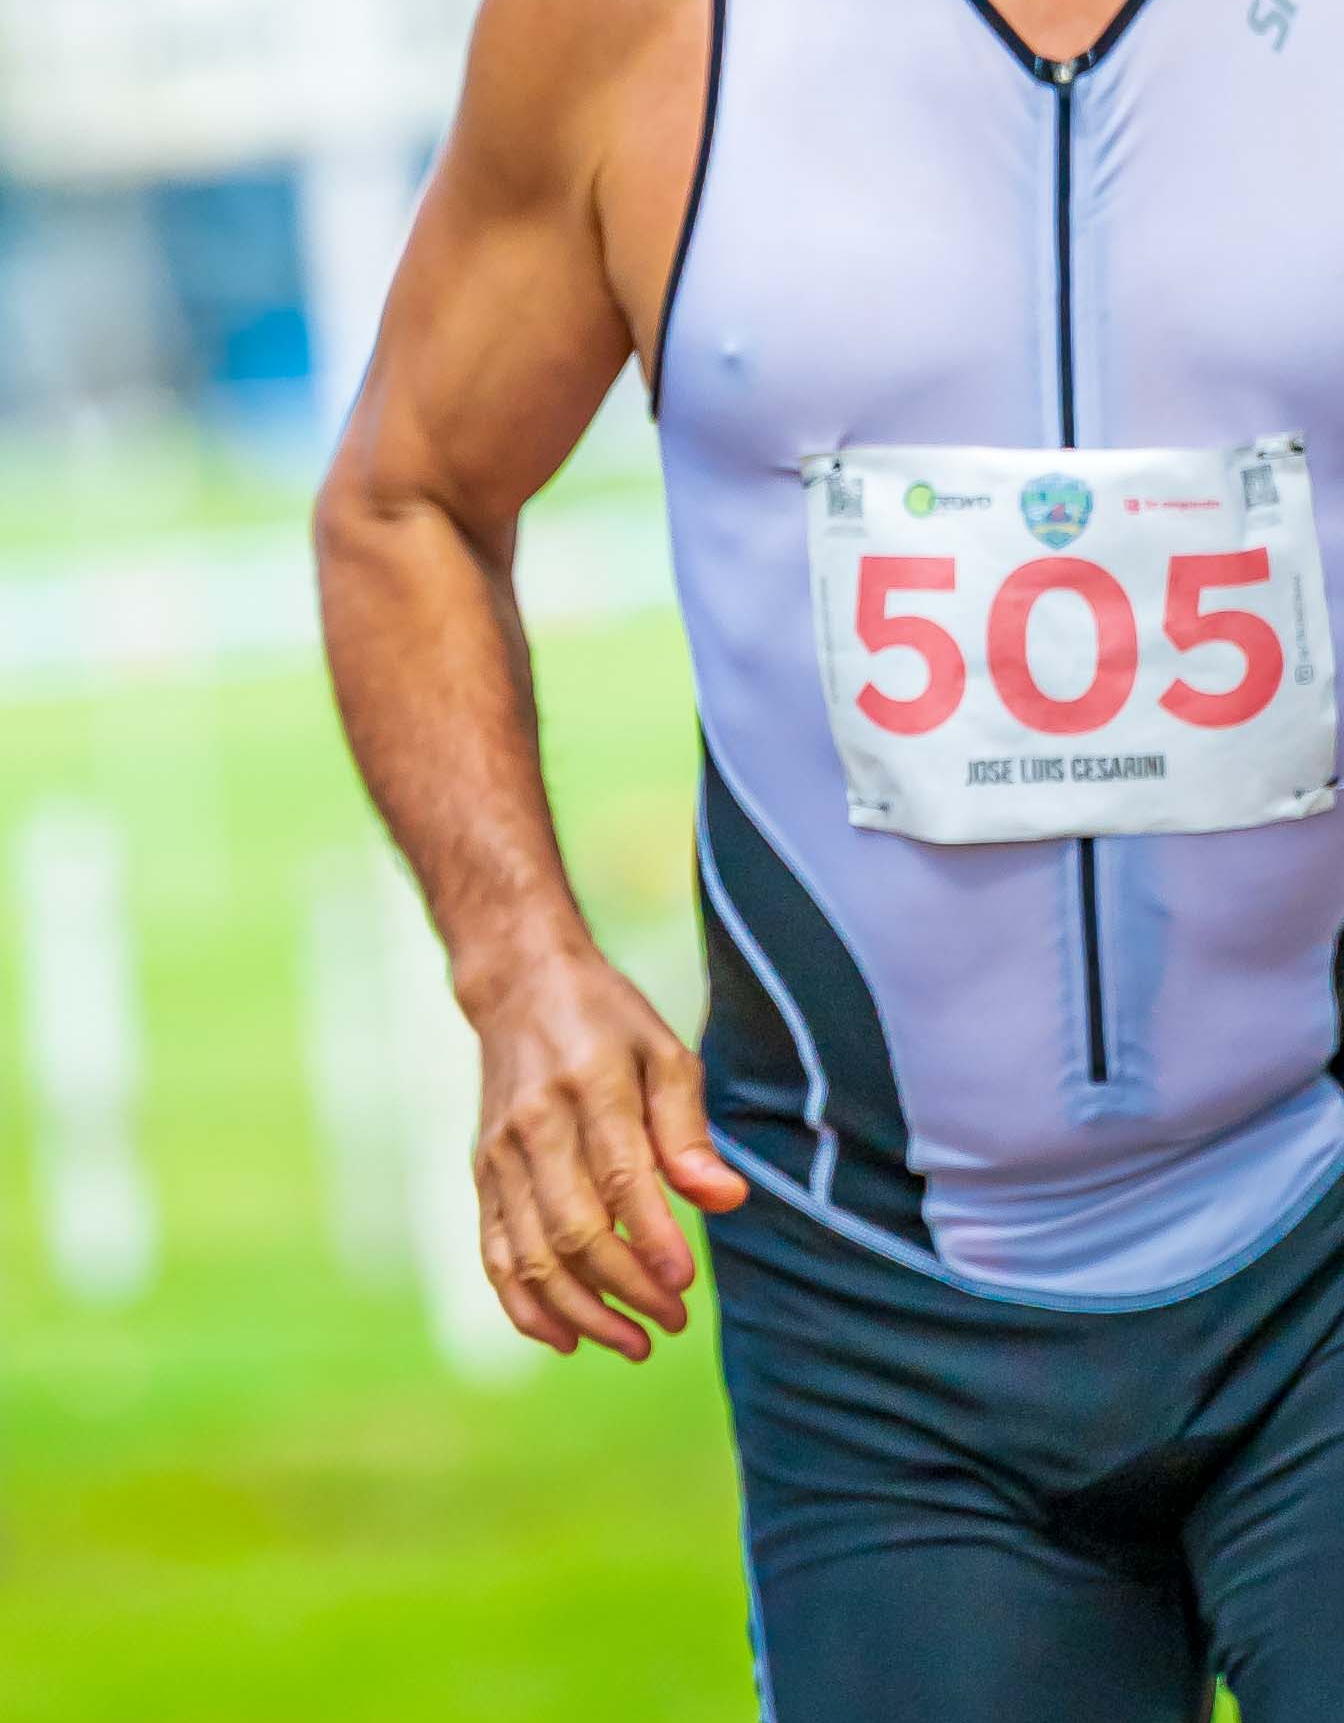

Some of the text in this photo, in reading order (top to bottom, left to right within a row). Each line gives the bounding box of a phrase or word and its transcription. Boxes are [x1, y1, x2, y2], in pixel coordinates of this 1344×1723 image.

[855, 547, 1285, 737] 505
[966, 760, 1014, 786] JOSE
[1020, 758, 1065, 783] LUIS
